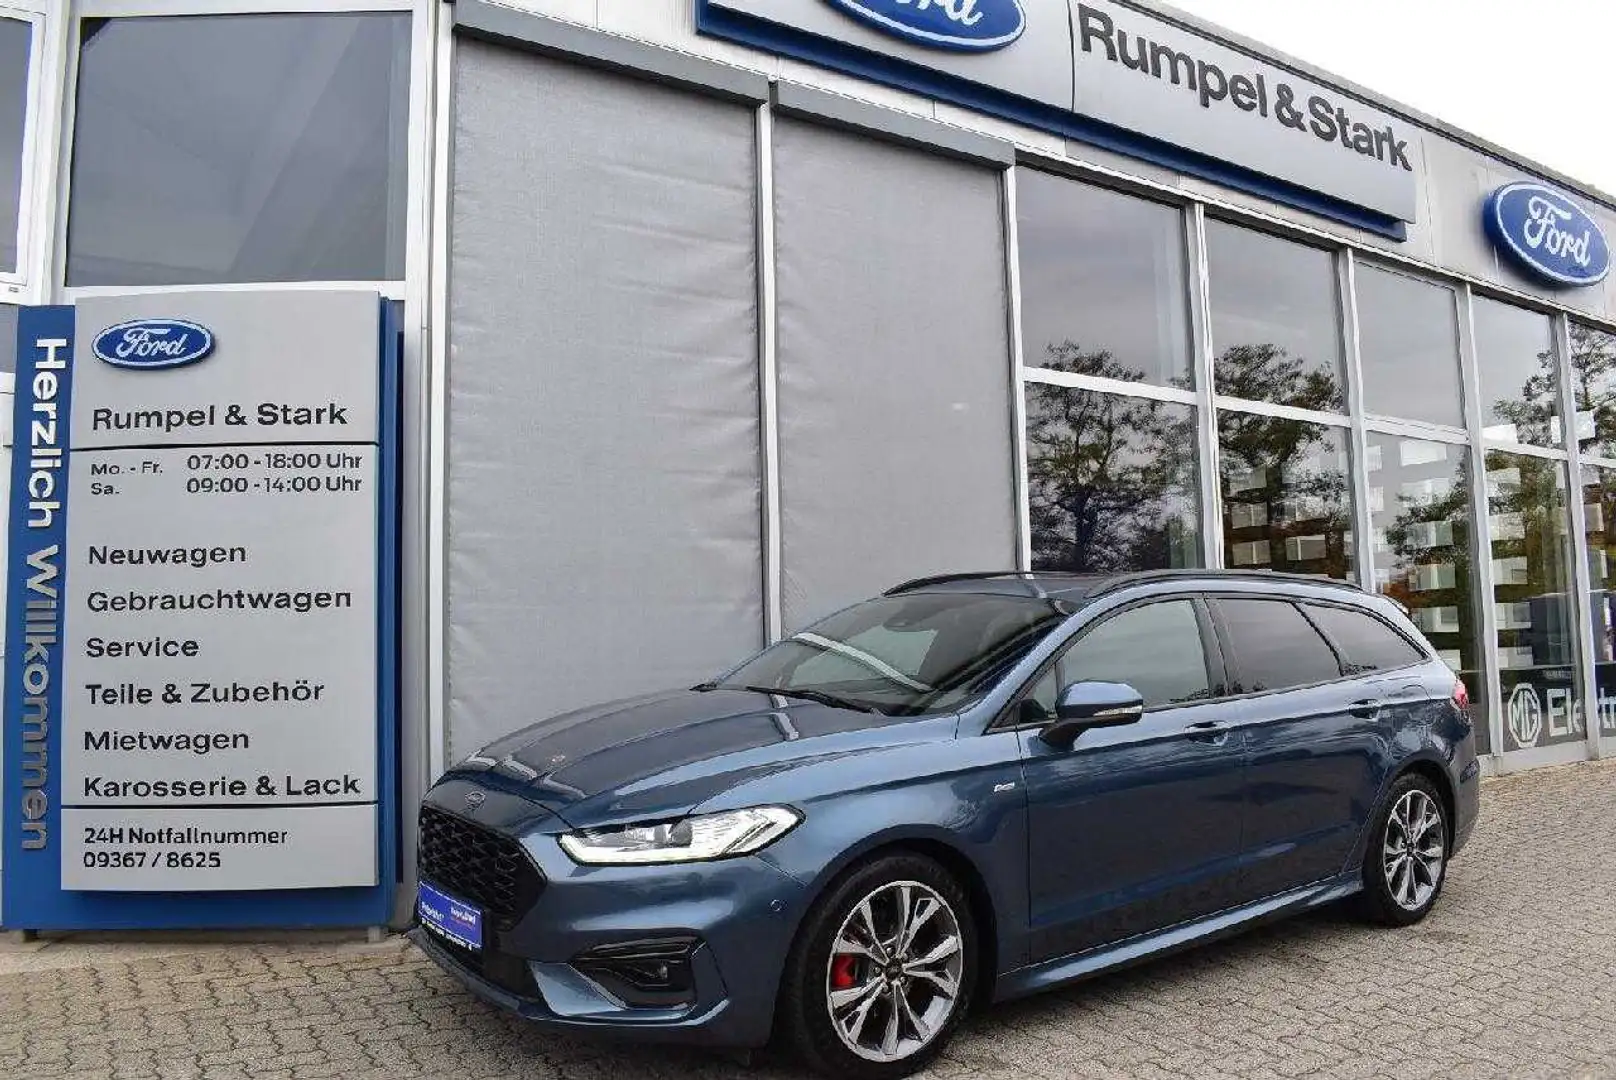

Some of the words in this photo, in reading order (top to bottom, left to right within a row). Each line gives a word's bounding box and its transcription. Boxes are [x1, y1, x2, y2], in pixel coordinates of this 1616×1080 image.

[1078, 3, 1268, 118] Rumpel
[1274, 83, 1307, 133] &
[1308, 96, 1413, 172] Stark
[1524, 196, 1591, 267] Ford
[116, 328, 189, 357] Ford
[92, 404, 216, 433] Rumpel
[224, 404, 248, 426] &
[256, 402, 348, 427] Stark
[27, 338, 67, 529] Herzlich
[90, 463, 125, 477] Mo.
[141, 461, 163, 475] Fr.
[186, 453, 249, 471] 07:00
[264, 453, 322, 470] 18:00
[326, 452, 363, 470] Uhr
[90, 482, 120, 496] Sa.
[186, 476, 249, 494] 09:00
[264, 476, 322, 493] 14:00
[325, 475, 364, 492] Uhr
[88, 545, 247, 569] Neuwagen
[86, 589, 352, 616] Gebrauchtwagen
[85, 637, 200, 658] Service
[20, 545, 60, 850] Willkommen
[85, 684, 154, 706] Teile
[161, 683, 182, 705] &
[190, 679, 325, 706] Zubehör
[84, 730, 250, 755] Mietwagen
[84, 775, 248, 798] Karosserie
[254, 775, 277, 797] &
[286, 774, 361, 797] Lack
[84, 827, 124, 845] 24H
[128, 827, 289, 845] Notfallnummer
[83, 851, 147, 869] 09367
[151, 852, 162, 869] /
[165, 851, 221, 869] 8625
